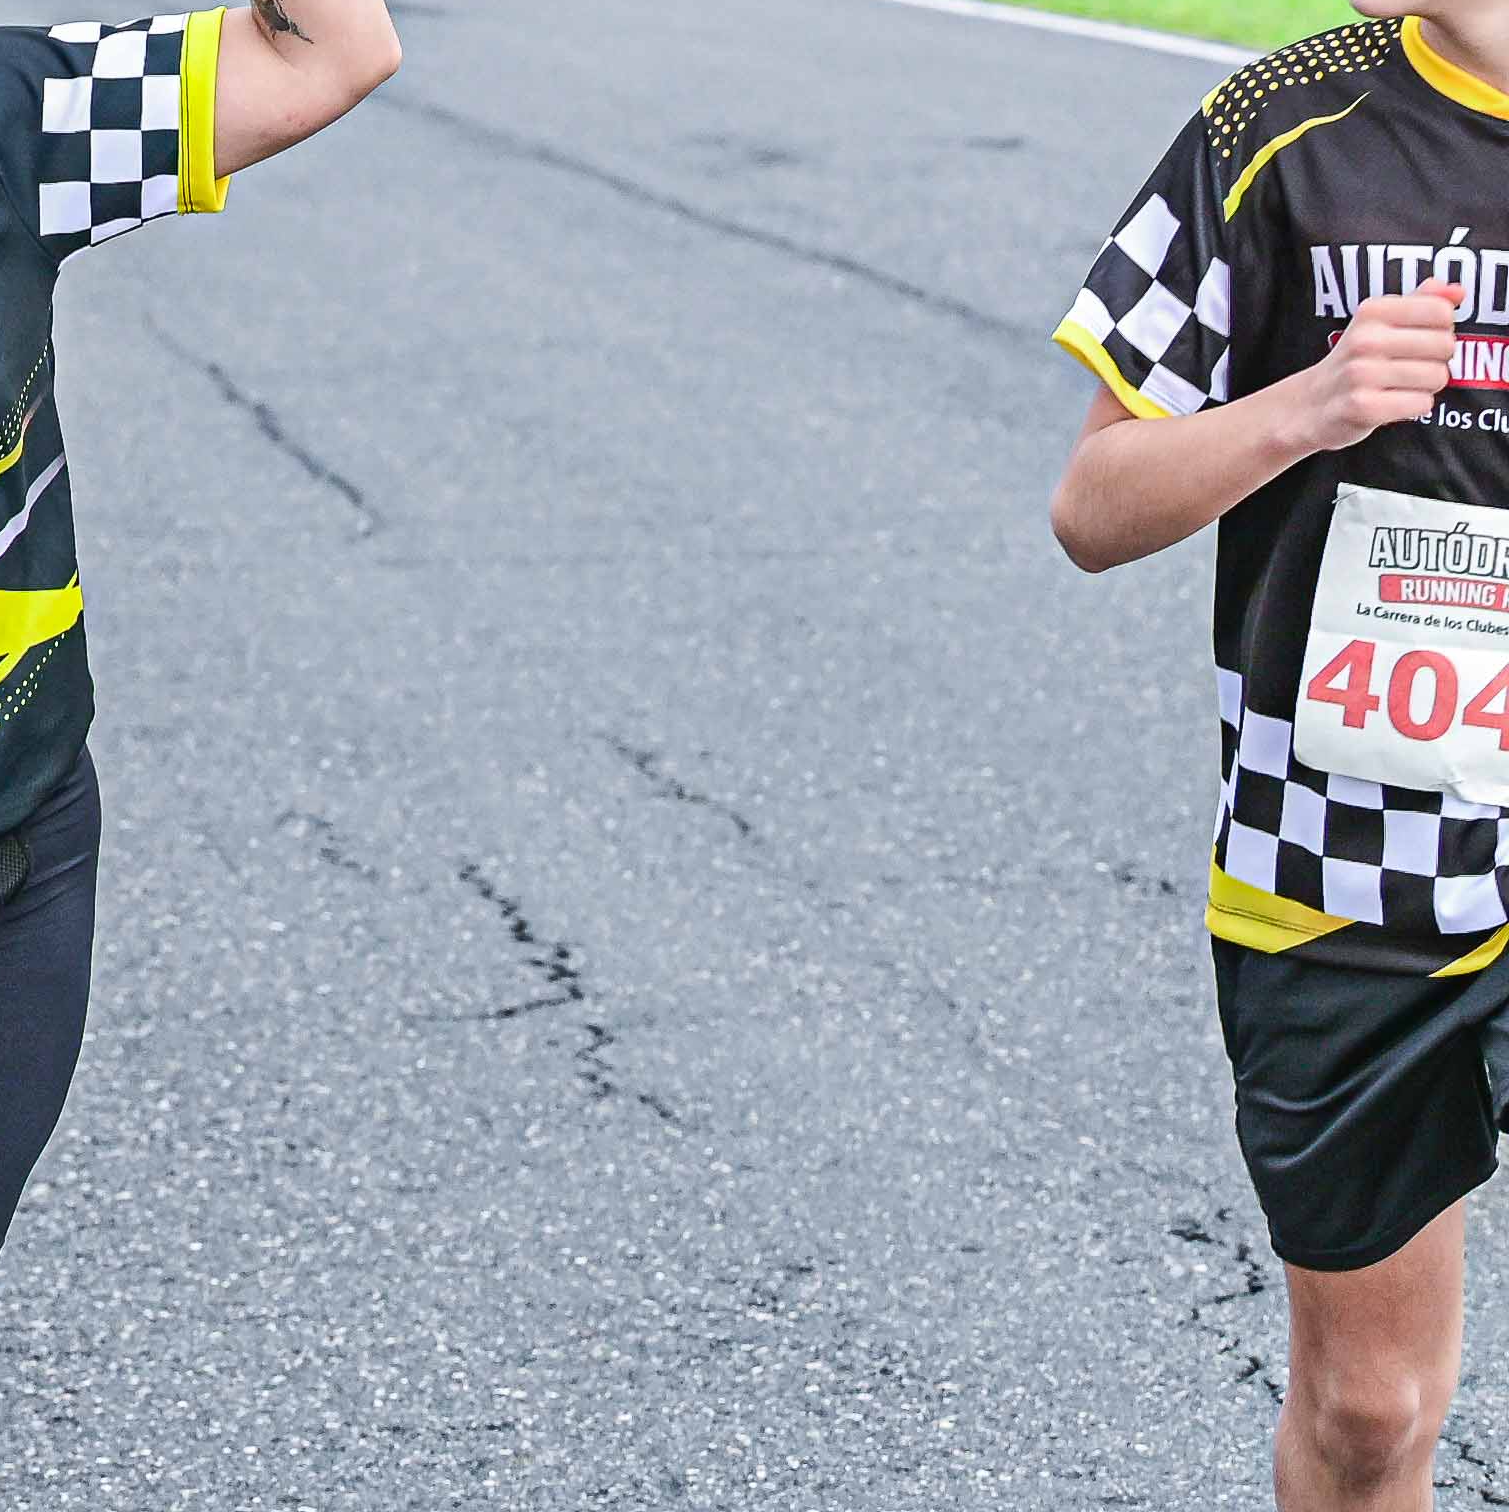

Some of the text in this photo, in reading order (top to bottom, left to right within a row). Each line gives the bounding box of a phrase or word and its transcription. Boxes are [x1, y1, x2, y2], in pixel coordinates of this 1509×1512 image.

[1310, 226, 1509, 326] AUTÓD
[1438, 402, 1472, 429] los
[1478, 408, 1509, 433] Clu
[1369, 521, 1509, 580] AUTÓDR
[1400, 578, 1496, 607] RUNNING
[1356, 602, 1370, 615] La
[1374, 606, 1420, 625] Carrera
[1424, 614, 1441, 627] de
[1444, 616, 1462, 630] los
